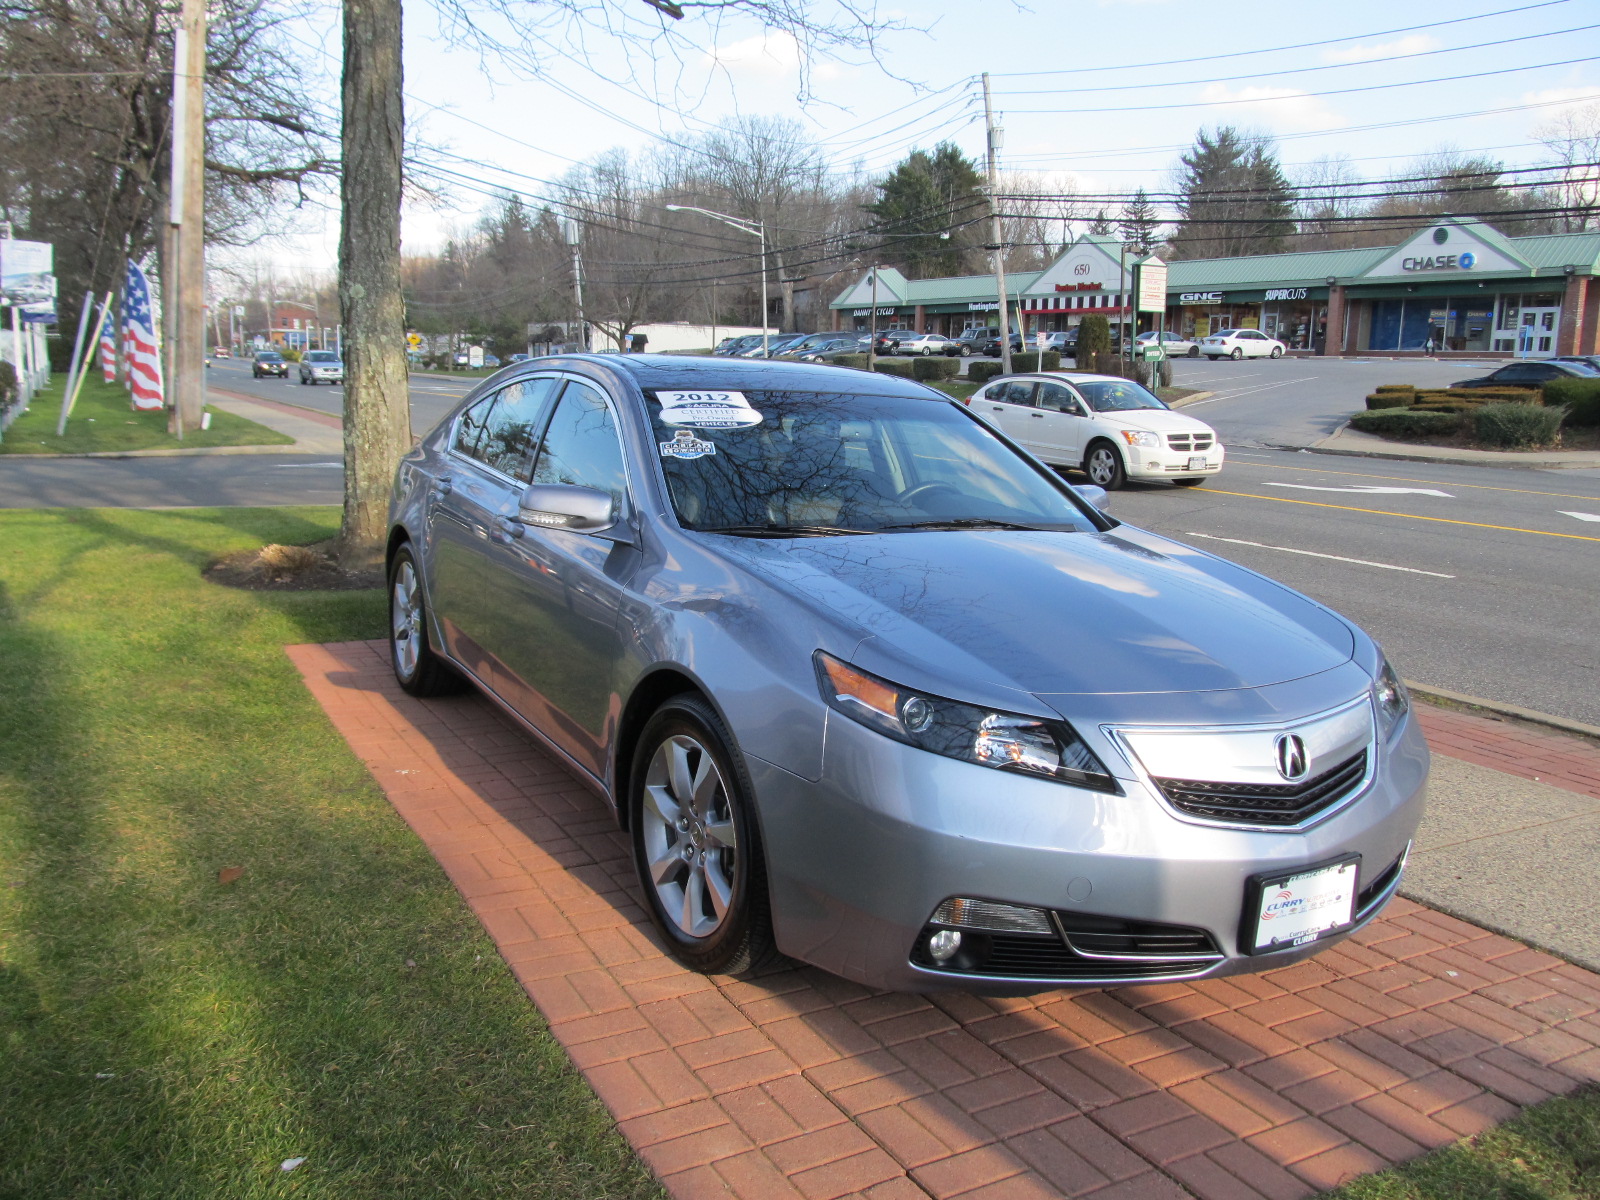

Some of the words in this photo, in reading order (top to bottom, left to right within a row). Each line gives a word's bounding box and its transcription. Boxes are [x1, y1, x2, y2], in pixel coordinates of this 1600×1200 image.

[1402, 254, 1458, 271] CHASE
[1074, 263, 1091, 276] 650
[1180, 291, 1223, 301] GNC
[1264, 288, 1308, 301] SUPERCUTS
[876, 307, 895, 316] CYCLES
[673, 393, 733, 402] 2012
[1266, 897, 1306, 912] CURRY
[1292, 932, 1320, 946] CURRY
